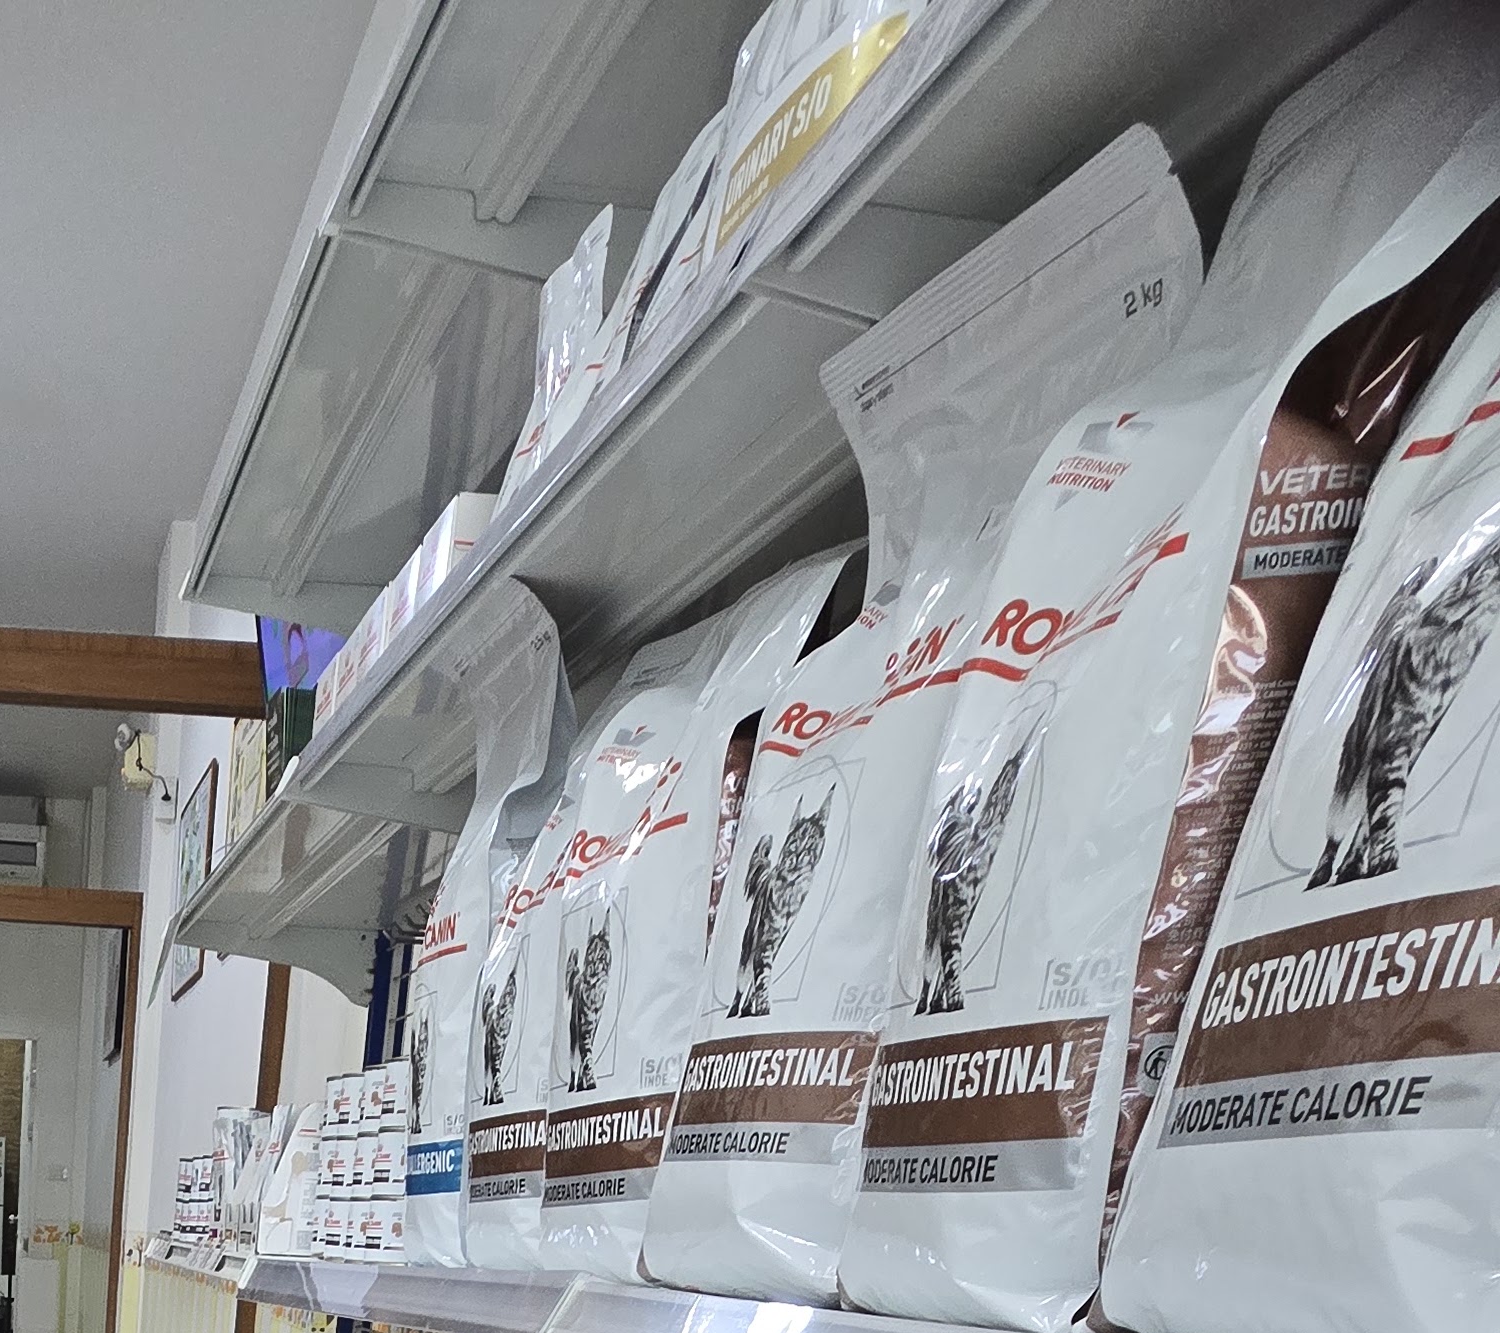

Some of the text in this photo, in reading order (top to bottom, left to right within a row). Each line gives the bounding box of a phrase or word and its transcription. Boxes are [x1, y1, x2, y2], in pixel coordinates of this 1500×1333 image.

[1123, 278, 1163, 317] 2 kg
[1201, 916, 1500, 1031] GASTROINTESTIN
[683, 1047, 855, 1094] GASTROINTESTINAL
[873, 1046, 1076, 1107] GASTROINTESTINAL
[1172, 1074, 1432, 1136] MODERATE CALORIE
[723, 1130, 790, 1155] CALORIE
[581, 1178, 625, 1199] CALORIE
[920, 1154, 998, 1184] CALORIE
